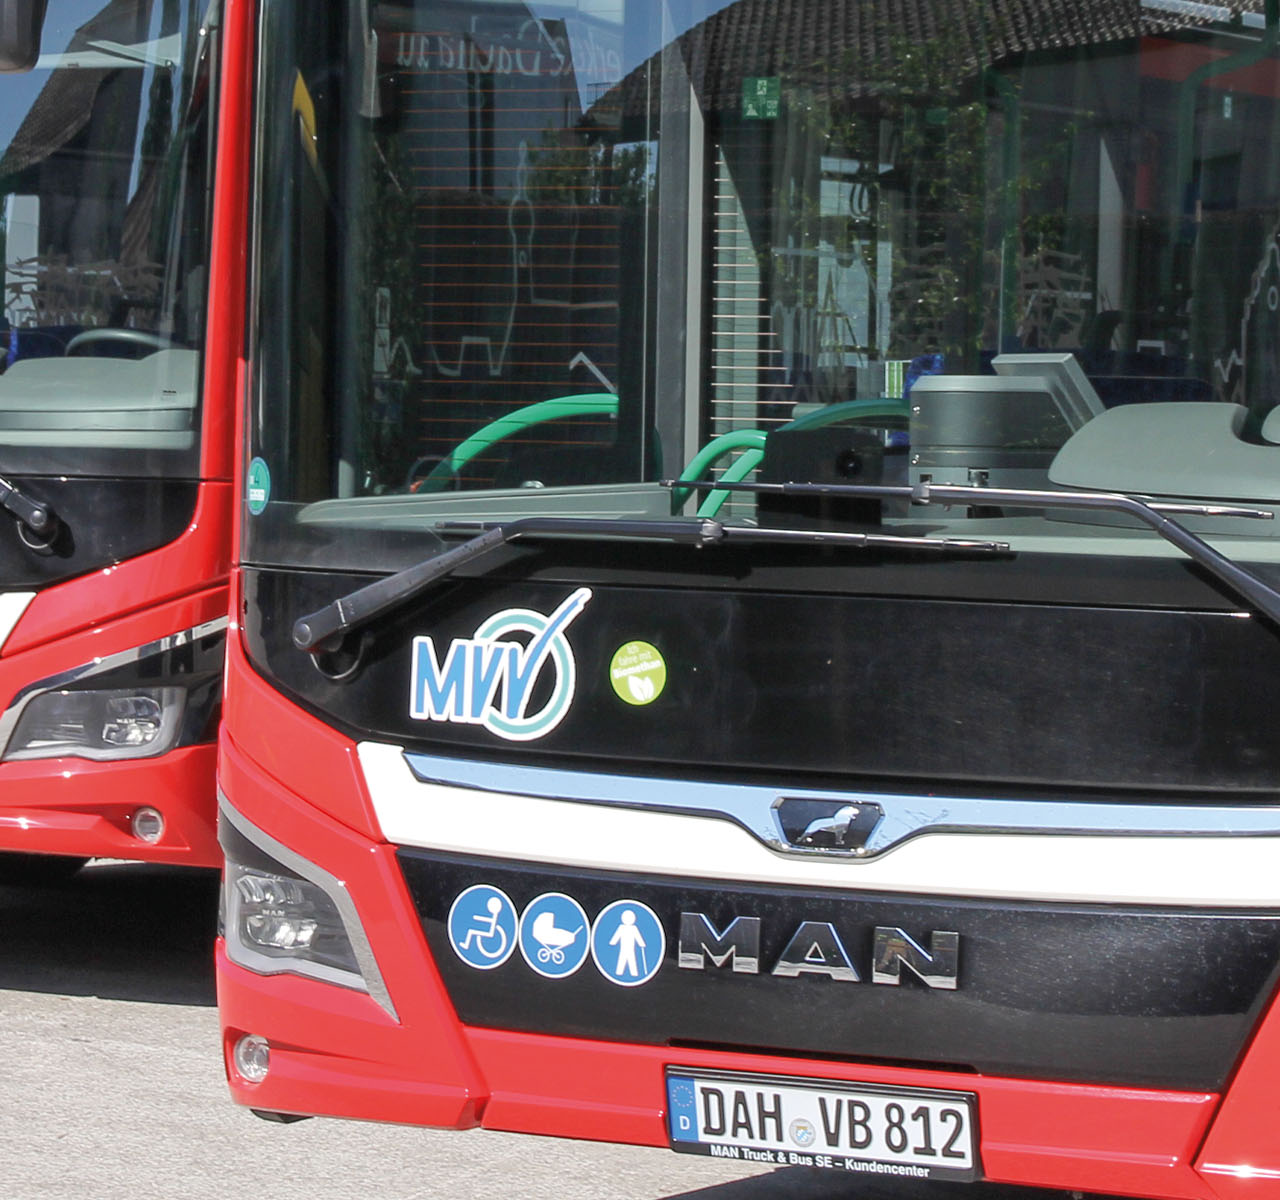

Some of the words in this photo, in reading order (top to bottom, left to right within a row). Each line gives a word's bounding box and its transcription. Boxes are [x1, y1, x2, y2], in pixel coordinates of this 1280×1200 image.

[678, 912, 960, 989] MAN
[679, 1115, 691, 1131] D
[700, 1086, 783, 1142] DAH
[818, 1097, 871, 1149] VB
[884, 1102, 966, 1159] 812
[710, 1144, 739, 1159] MAN
[741, 1148, 775, 1162] Truck
[777, 1153, 787, 1164] &
[789, 1154, 813, 1167] Bus
[815, 1156, 833, 1168] SE
[845, 1158, 930, 1178] Kundencenter
